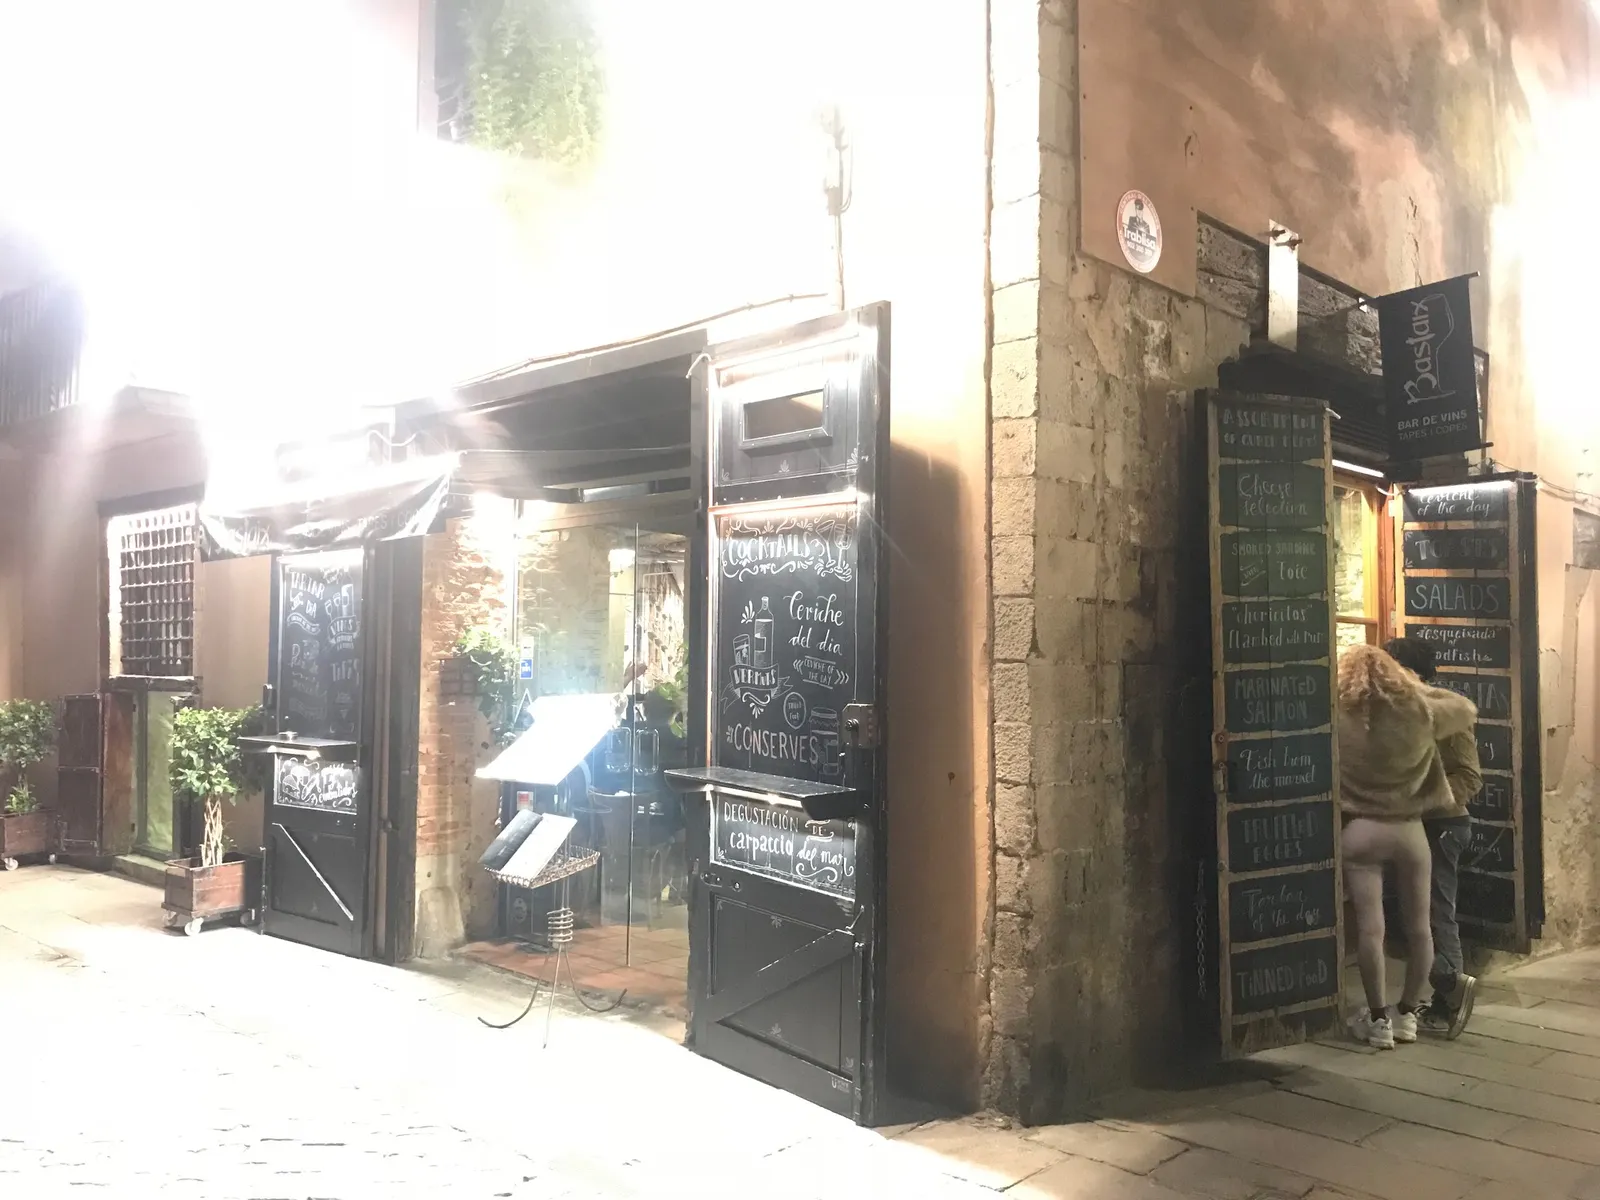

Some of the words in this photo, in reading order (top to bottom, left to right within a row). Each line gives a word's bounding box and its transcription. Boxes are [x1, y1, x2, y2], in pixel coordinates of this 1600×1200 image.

[1404, 300, 1439, 404] Bastaix
[1398, 419, 1419, 431] BAR
[1423, 415, 1437, 426] DE
[1441, 410, 1467, 422] VINS
[1398, 428, 1427, 440] TAPES
[1436, 423, 1467, 435] COPES
[1418, 505, 1429, 516] of
[1438, 501, 1456, 515] the
[1466, 501, 1490, 517] day
[728, 532, 813, 566] COCKTAILS
[1411, 584, 1499, 613] SALADS
[788, 625, 812, 649] del
[1433, 648, 1481, 662] odfish
[1234, 675, 1317, 699] MARINATED
[1243, 700, 1308, 724] SALMON
[734, 723, 819, 765] CONSERVES
[724, 802, 799, 833] DEGUSTACIÓN
[812, 825, 824, 836] DE
[730, 831, 793, 860] carpaccio
[797, 842, 817, 870] del
[821, 852, 854, 877] mar
